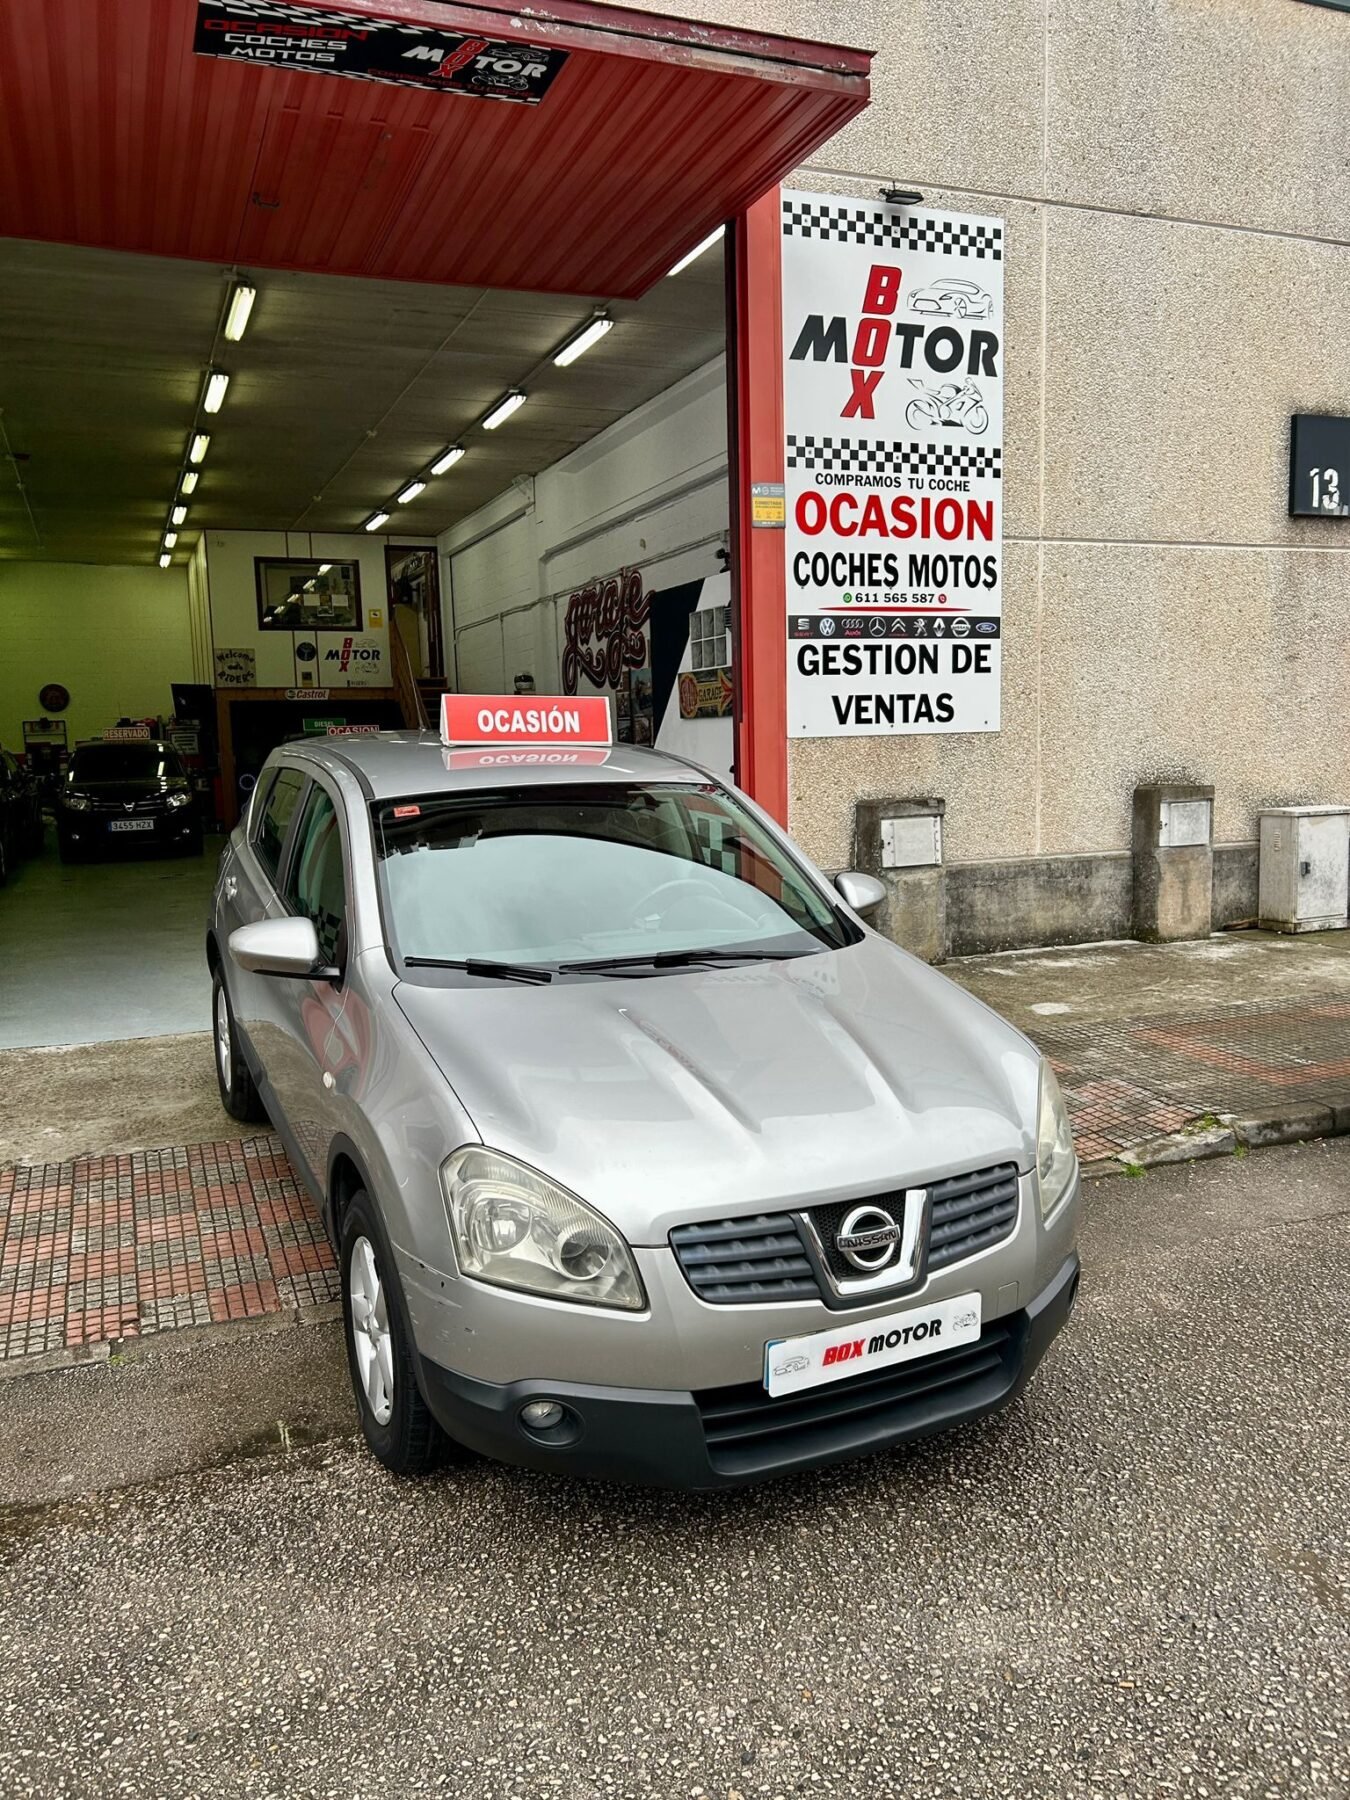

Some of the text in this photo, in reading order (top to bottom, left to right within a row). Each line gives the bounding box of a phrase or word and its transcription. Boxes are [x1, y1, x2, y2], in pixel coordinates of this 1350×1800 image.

[203, 18, 369, 41] OCASION
[224, 33, 347, 51] COCHES
[231, 46, 336, 63] MOTOS
[789, 314, 999, 377] MOTOR
[840, 264, 902, 420] BOX
[815, 473, 970, 492] COMPRAMOS TU COCHE
[1309, 467, 1340, 510] 13
[795, 491, 993, 541] OCASION
[793, 551, 997, 588] COCHES MOTOS
[855, 592, 935, 603] 611 565 587
[797, 644, 991, 676] GESTION DE
[296, 689, 327, 699] Castrol
[698, 686, 722, 702] GARAGE
[477, 705, 581, 733] OCASIÓN
[831, 693, 955, 725] VENTAS
[104, 729, 148, 738] RESERVADO
[846, 1230, 897, 1248] NISSAN
[822, 1318, 942, 1367] BOX MOTOR
